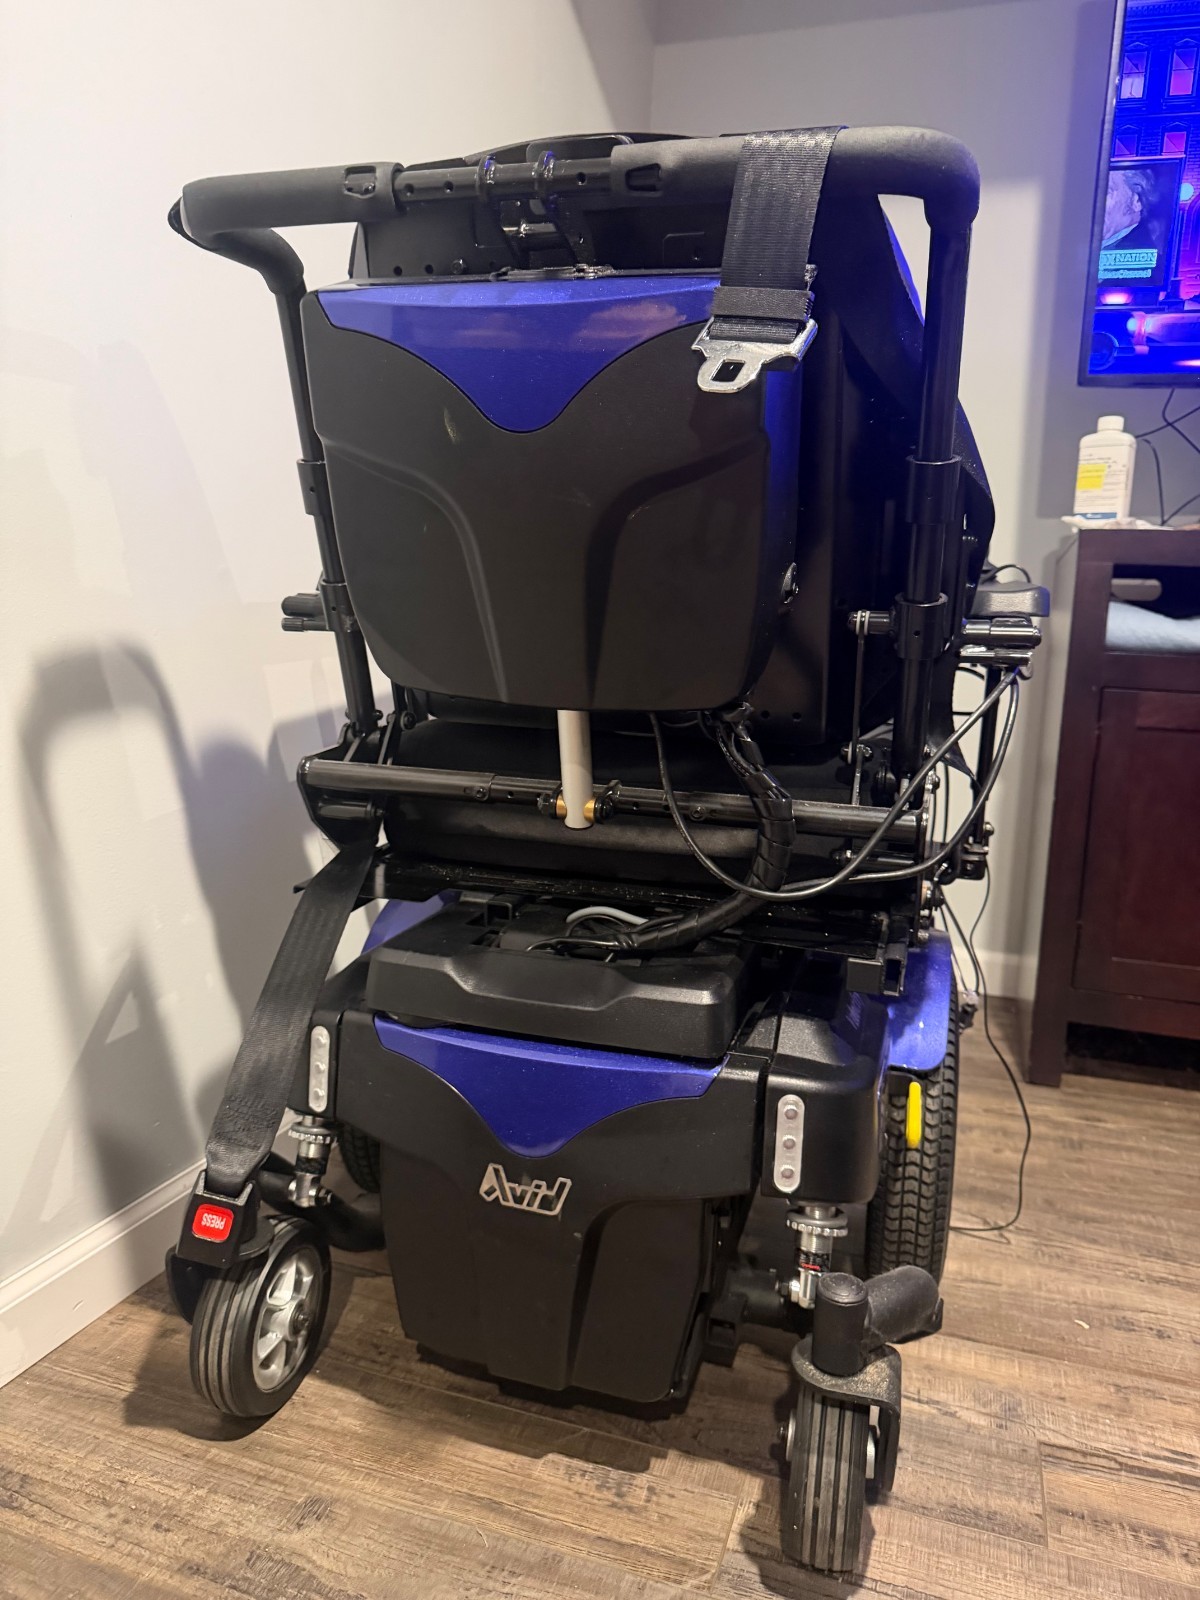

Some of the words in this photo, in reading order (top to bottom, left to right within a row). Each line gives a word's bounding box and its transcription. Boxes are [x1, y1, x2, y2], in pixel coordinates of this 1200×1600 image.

[1115, 252, 1155, 262] NATION
[479, 1163, 572, 1216] Avid
[201, 1213, 226, 1230] PRESS
